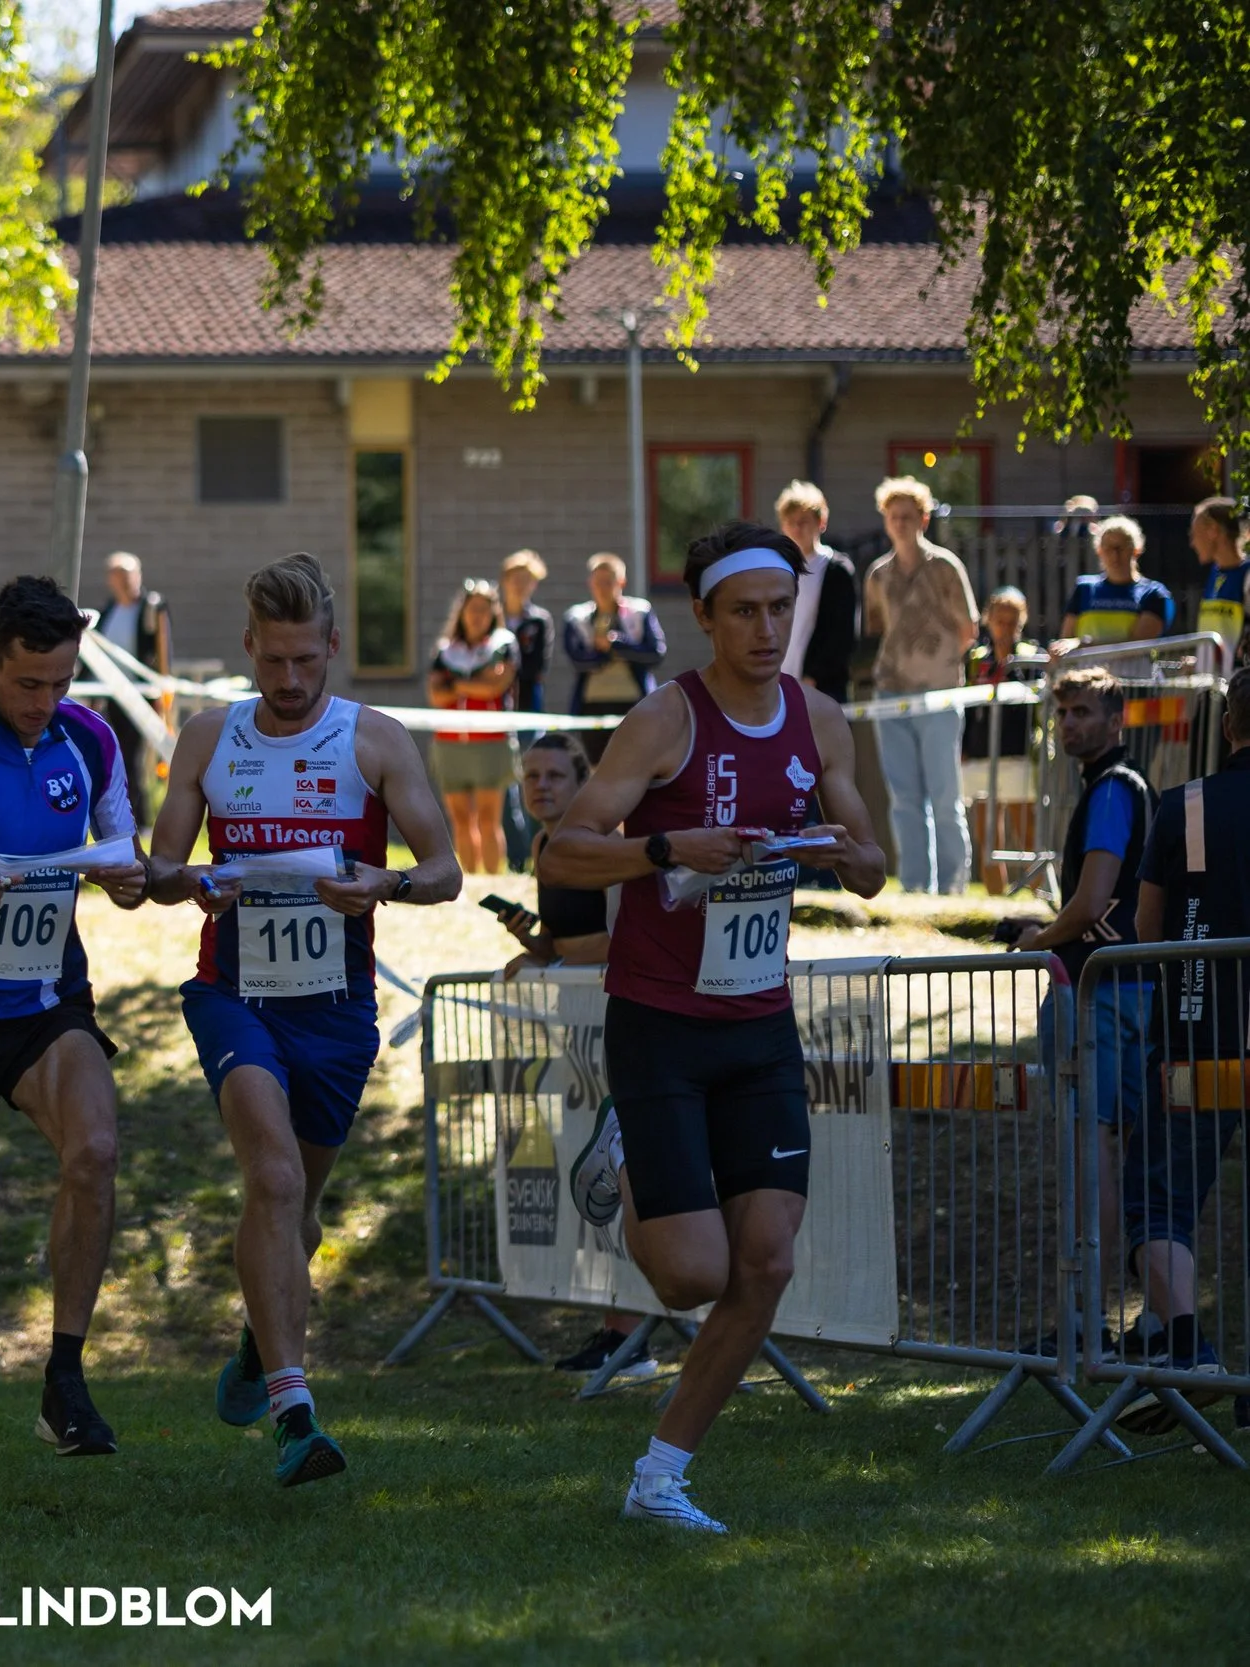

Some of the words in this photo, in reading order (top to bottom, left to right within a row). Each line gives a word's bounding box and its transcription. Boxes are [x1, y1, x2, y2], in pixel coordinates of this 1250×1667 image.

[311, 729, 344, 753] headlight
[46, 772, 74, 797] BV
[296, 779, 315, 788] ICA
[226, 801, 262, 812] Kumla
[295, 799, 313, 808] ICA
[225, 824, 256, 843] OK
[260, 824, 345, 845] Tisaren
[57, 881, 70, 889] 2025
[740, 889, 784, 900] SPRINTDISTANS
[259, 916, 327, 963] 110
[723, 909, 780, 960] 108
[19, 964, 60, 972] VOLVO
[296, 974, 343, 987] VOLVO
[750, 971, 783, 984] VOLVO
[508, 1178, 558, 1208] SVENSK
